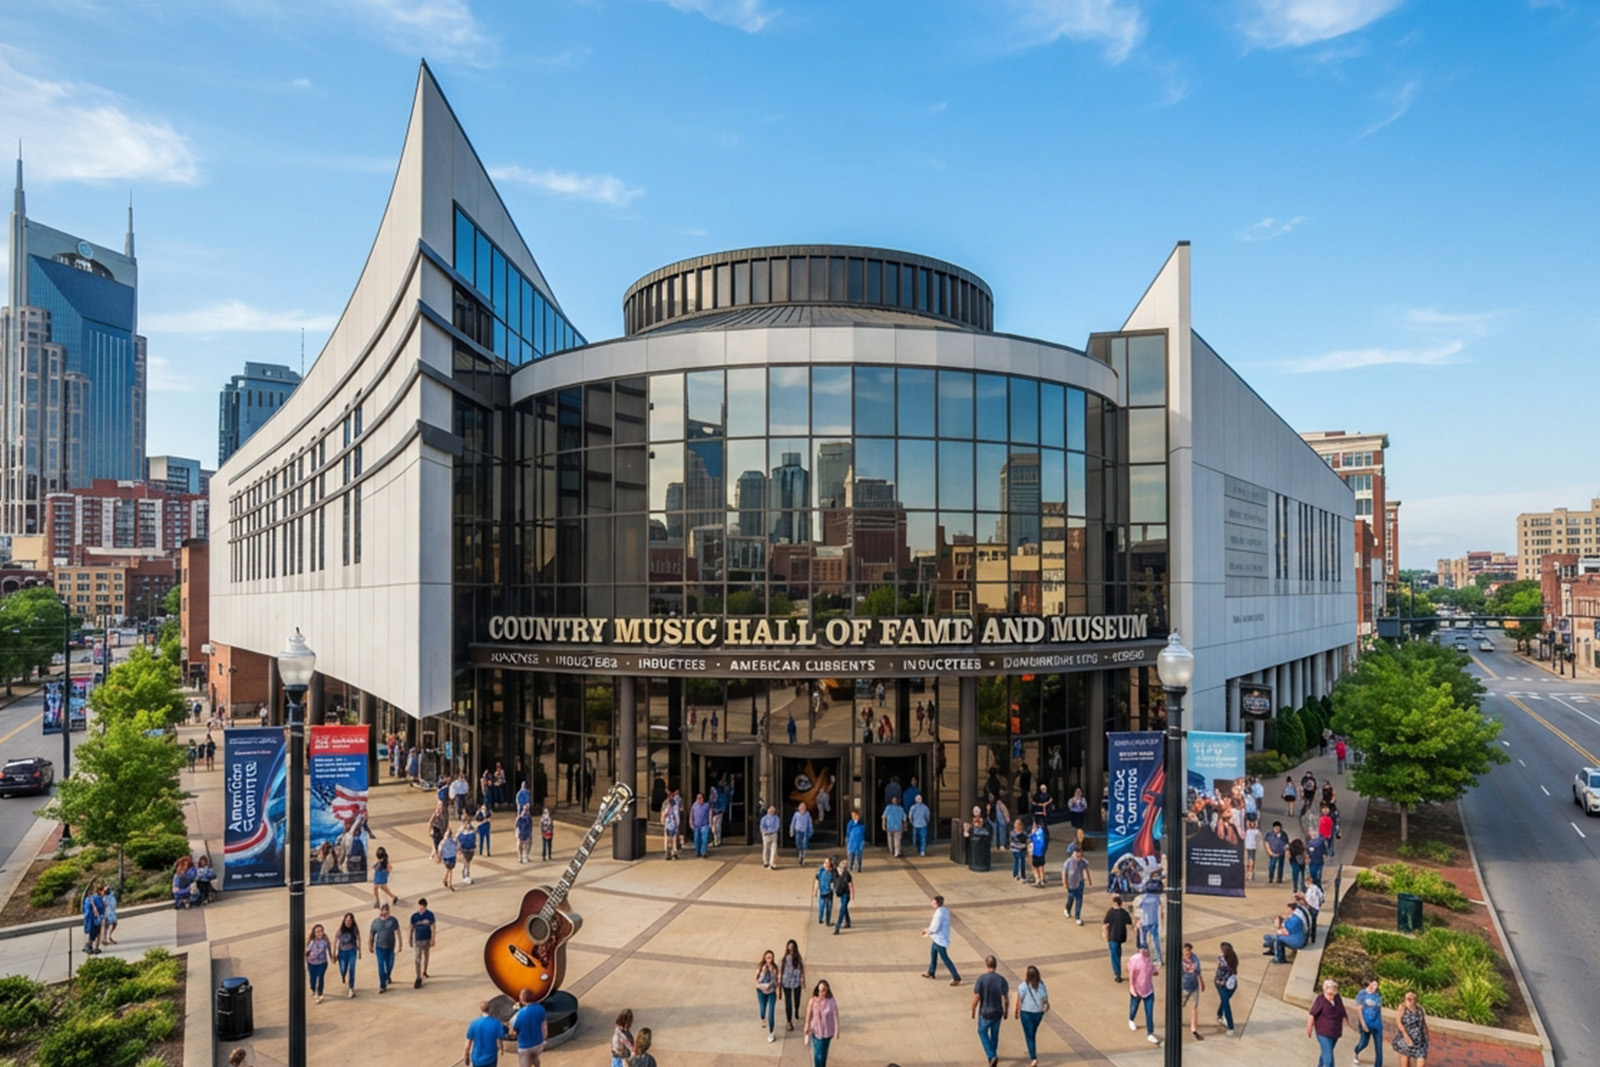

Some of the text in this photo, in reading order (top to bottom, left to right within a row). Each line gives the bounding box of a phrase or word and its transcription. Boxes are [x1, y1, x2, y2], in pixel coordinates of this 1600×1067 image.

[488, 613, 1149, 646] COUNTRY MUSIC HALL OF FAME AND MUSEUM
